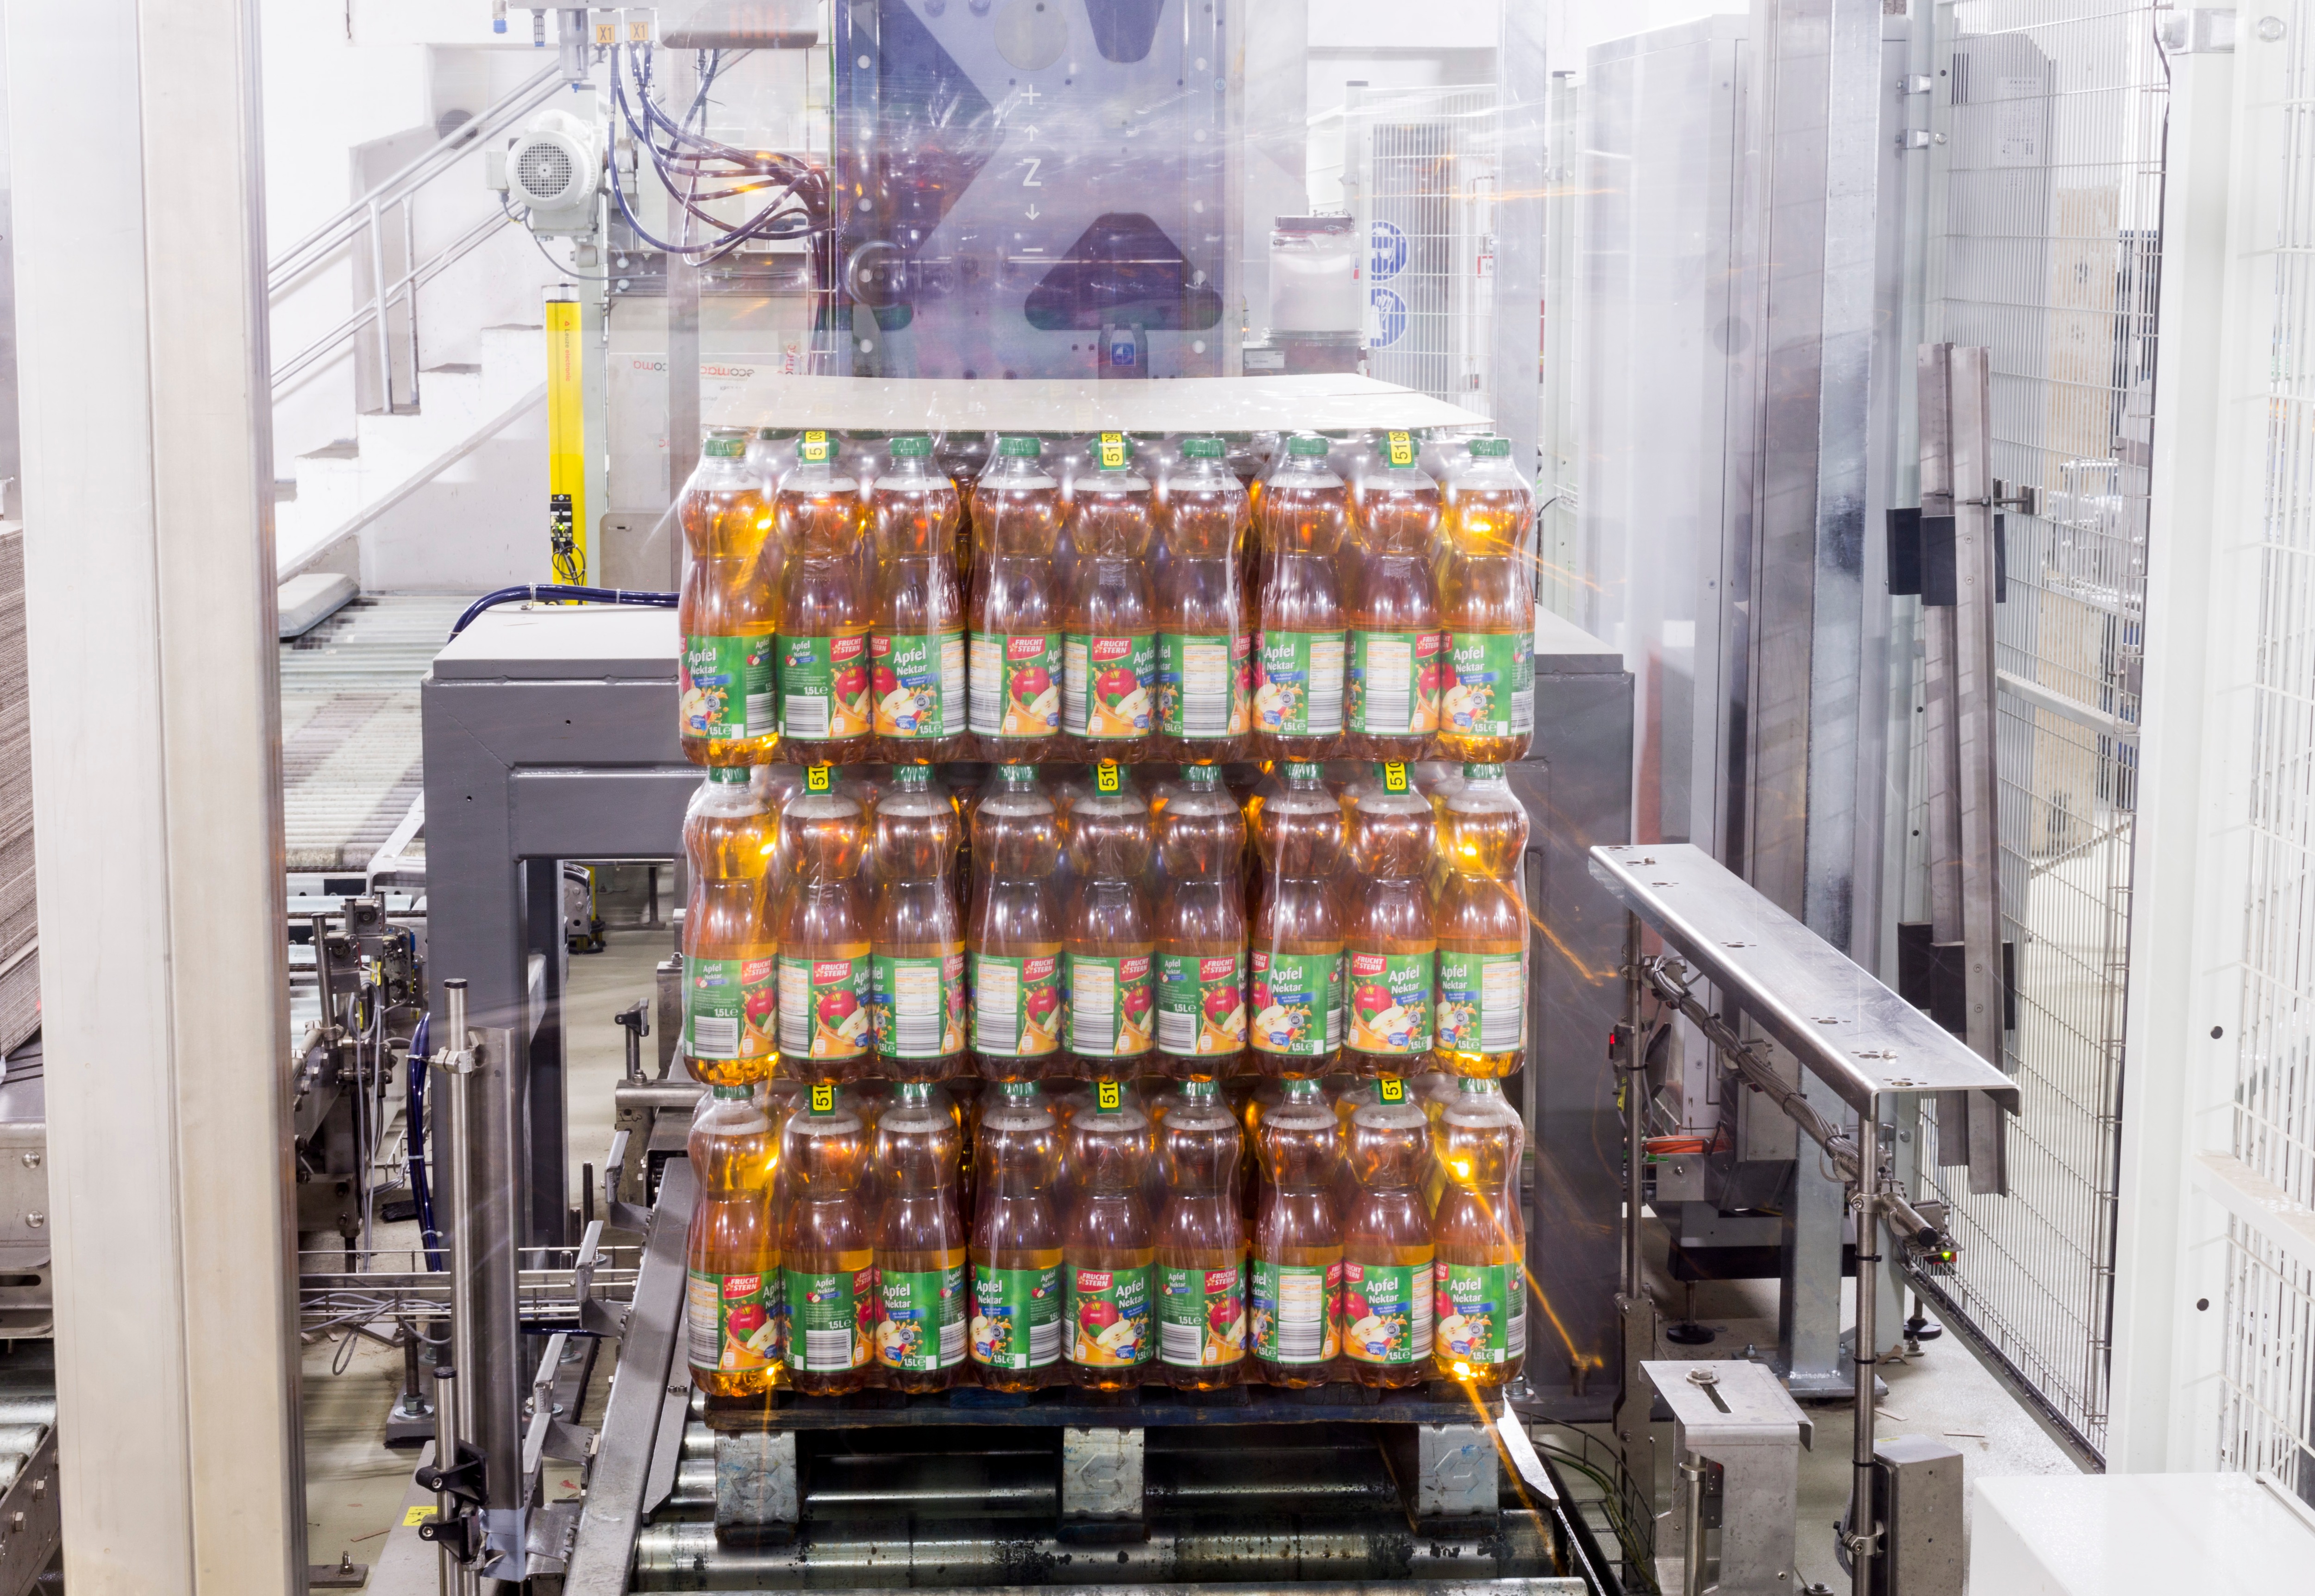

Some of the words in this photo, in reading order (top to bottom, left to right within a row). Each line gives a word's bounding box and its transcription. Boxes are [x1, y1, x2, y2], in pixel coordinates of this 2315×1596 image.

[600, 26, 612, 41] X1
[633, 24, 645, 38] X1
[1023, 158, 1041, 187] Z
[700, 365, 755, 377] ecomac
[1105, 434, 1120, 462] 5109
[1392, 432, 1408, 460] 5109
[756, 637, 769, 650] Apfel
[792, 640, 810, 651] Apfel
[838, 638, 861, 647] FRUCHT
[841, 645, 860, 653] STERN
[1264, 644, 1294, 661] Apfel
[1454, 645, 1483, 663] Apfel
[688, 647, 716, 666] Apfel
[893, 646, 926, 666] Apfel
[690, 666, 717, 675] Nektar
[897, 664, 927, 675] Nektar
[1267, 661, 1295, 670] Nektar
[1456, 663, 1484, 673] Nektar
[811, 765, 826, 786] 51
[749, 960, 771, 969] FRUCHT
[1031, 959, 1054, 967] FRUCHT
[1127, 958, 1148, 966] FRUCHT
[1165, 959, 1180, 969] Apfel
[703, 963, 721, 974] Apfel
[752, 967, 770, 976] STERN
[1033, 965, 1052, 973] STERN
[1441, 964, 1466, 980] Apfel
[1272, 966, 1302, 984] Apfel
[1388, 965, 1419, 985] Apfel
[1273, 983, 1302, 992] Nektar
[1391, 983, 1420, 994] Nektar
[1443, 980, 1468, 989] Nektar
[1384, 1080, 1399, 1096] 51
[815, 1085, 830, 1106] 51
[1041, 1269, 1055, 1283] Apfel
[1169, 1272, 1185, 1281] Apfel
[1213, 1270, 1236, 1279] FRUCHT
[815, 1277, 835, 1289] Apfel
[1043, 1279, 1055, 1288] Nektar
[1215, 1277, 1235, 1286] STERN
[1366, 1277, 1398, 1295] Apfel
[1451, 1278, 1481, 1294] Apfel
[883, 1283, 910, 1300] Apfel
[976, 1280, 1002, 1295] Apfel
[1115, 1277, 1144, 1298] Apfel
[885, 1300, 911, 1308] Nektar
[978, 1295, 1002, 1304] Nektar
[1119, 1294, 1144, 1309] Nektar
[1369, 1295, 1399, 1303] Nektar
[1453, 1294, 1482, 1303] Nektar
